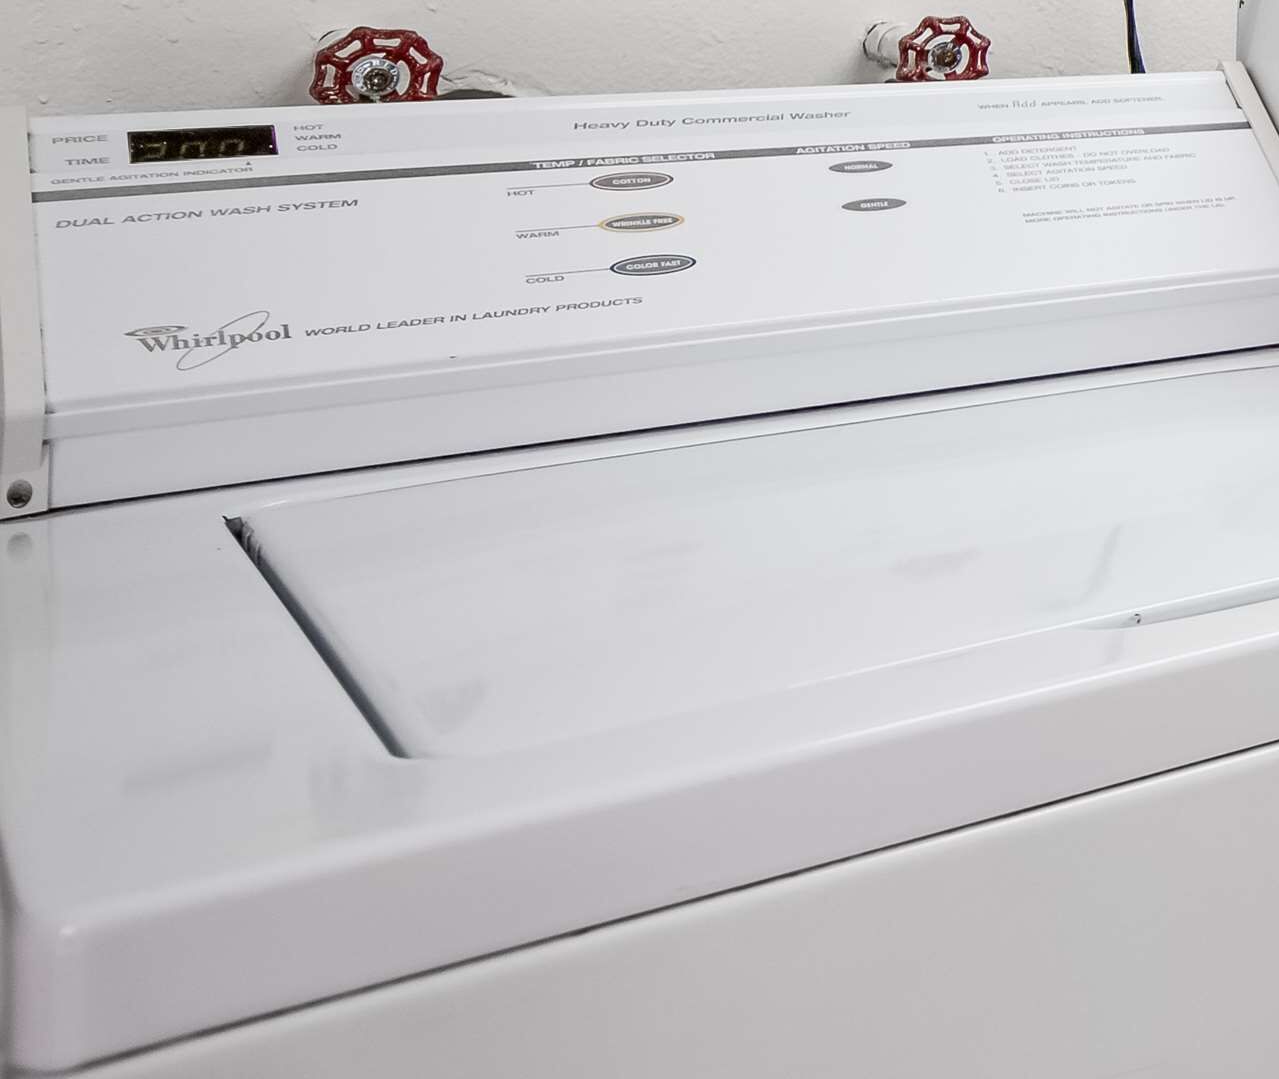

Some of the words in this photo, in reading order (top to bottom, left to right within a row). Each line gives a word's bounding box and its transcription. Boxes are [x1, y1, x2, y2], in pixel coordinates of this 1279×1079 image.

[572, 120, 632, 130] Heavy
[635, 118, 678, 128] Duty
[679, 113, 785, 125] Commercial
[788, 110, 852, 119] Washer
[52, 135, 108, 144] PRICE
[296, 133, 342, 141] WARM
[991, 133, 1059, 142] OPERATING
[1060, 128, 1146, 138] INSTRUCTIONS
[296, 144, 339, 152] COLD
[794, 144, 865, 153] AGITATION
[64, 157, 112, 166] TIME
[531, 159, 576, 168] TEMP
[586, 156, 640, 165] FABRIC
[641, 152, 716, 162] SELECTOR
[50, 177, 105, 185] GENTLE
[109, 171, 180, 181] AGITATION
[183, 167, 254, 177] INDICATOR
[55, 217, 115, 229] DUAL
[122, 210, 202, 223] ACTION
[210, 205, 272, 217] WASH
[277, 199, 359, 212] SYSTEM
[515, 230, 560, 239] WARM
[625, 261, 659, 270] COLOR
[525, 275, 565, 284] COLD
[304, 323, 371, 337] WORLD
[375, 315, 445, 330] LEADER
[448, 313, 467, 322] IN
[471, 305, 551, 320] LAUNDRY
[553, 295, 644, 312] PRODUCTS
[138, 322, 292, 354] Whirlpool
